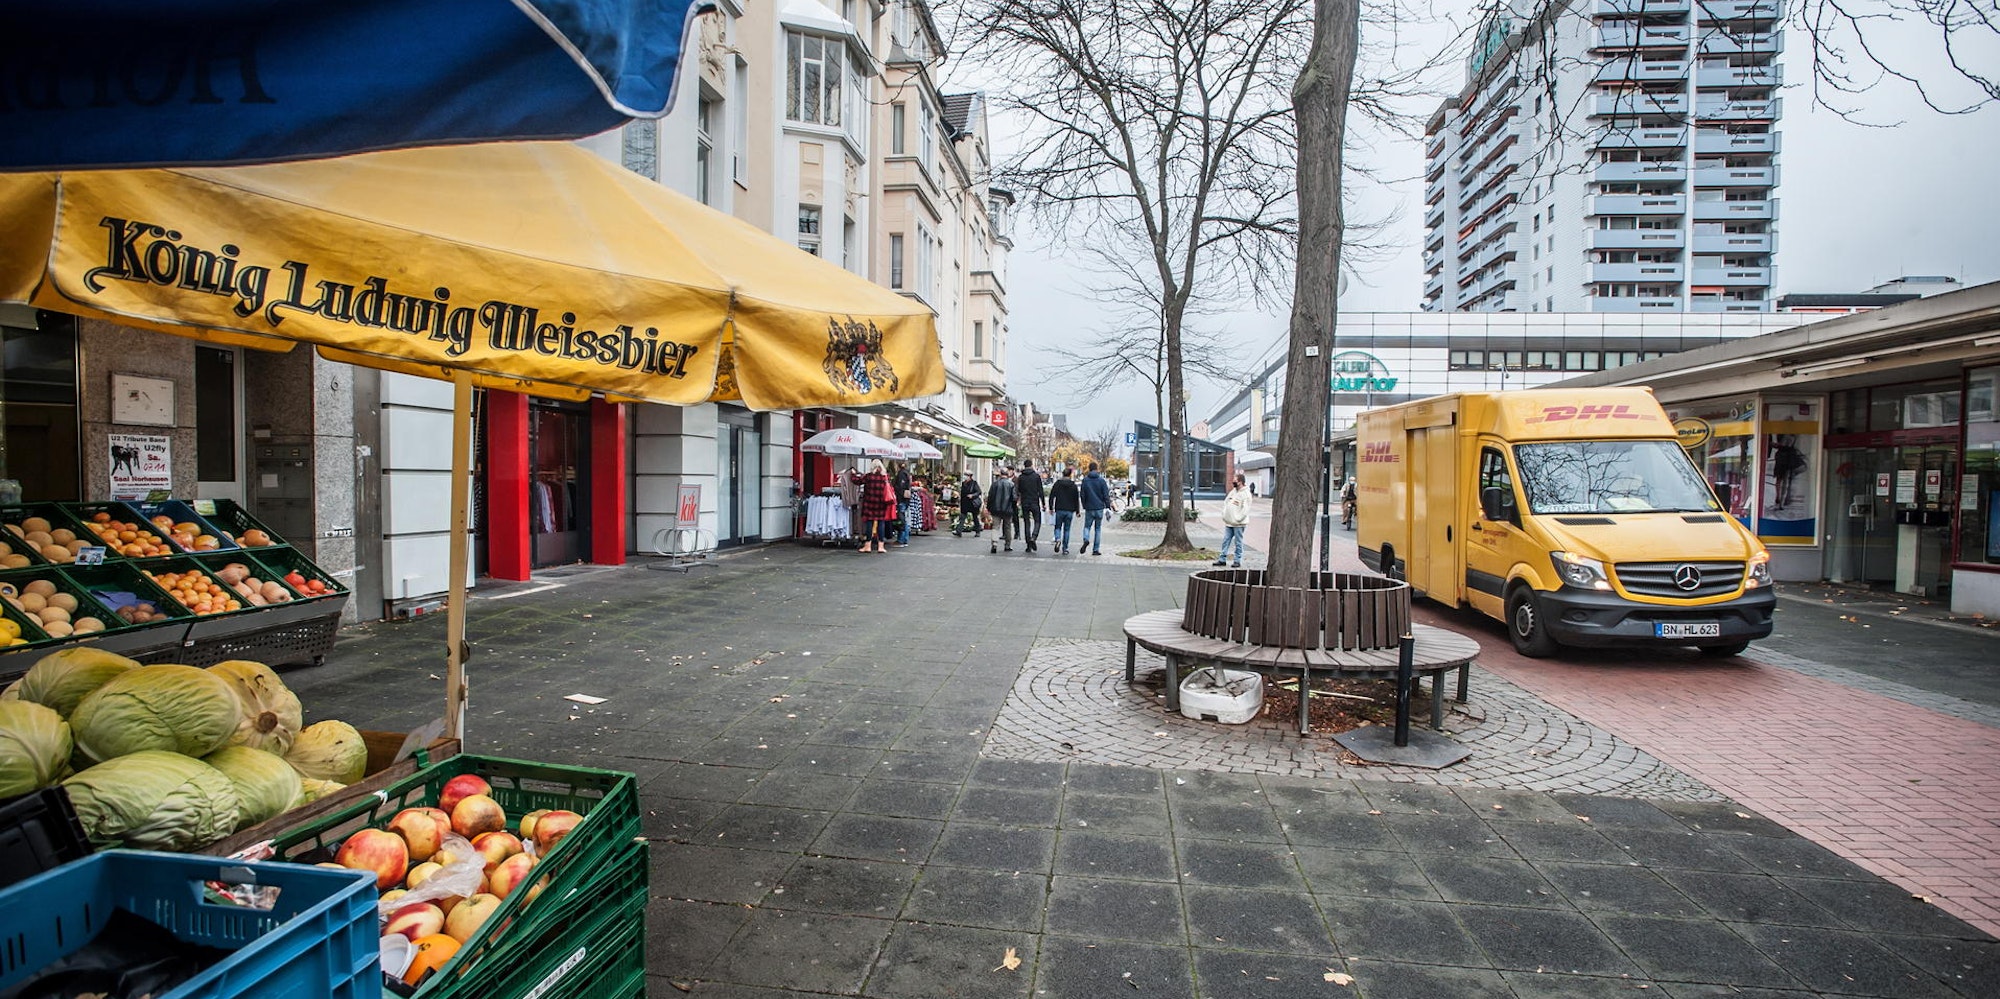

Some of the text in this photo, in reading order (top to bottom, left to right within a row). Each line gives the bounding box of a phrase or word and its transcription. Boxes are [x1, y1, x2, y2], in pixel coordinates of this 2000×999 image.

[84, 216, 699, 380] König Ludwig Weissbier
[1543, 405, 1640, 422] DHL
[144, 445, 166, 453] U2fly
[1365, 441, 1393, 463] DHL
[680, 494, 697, 521] kik
[1663, 625, 1718, 634] BN HL 623
